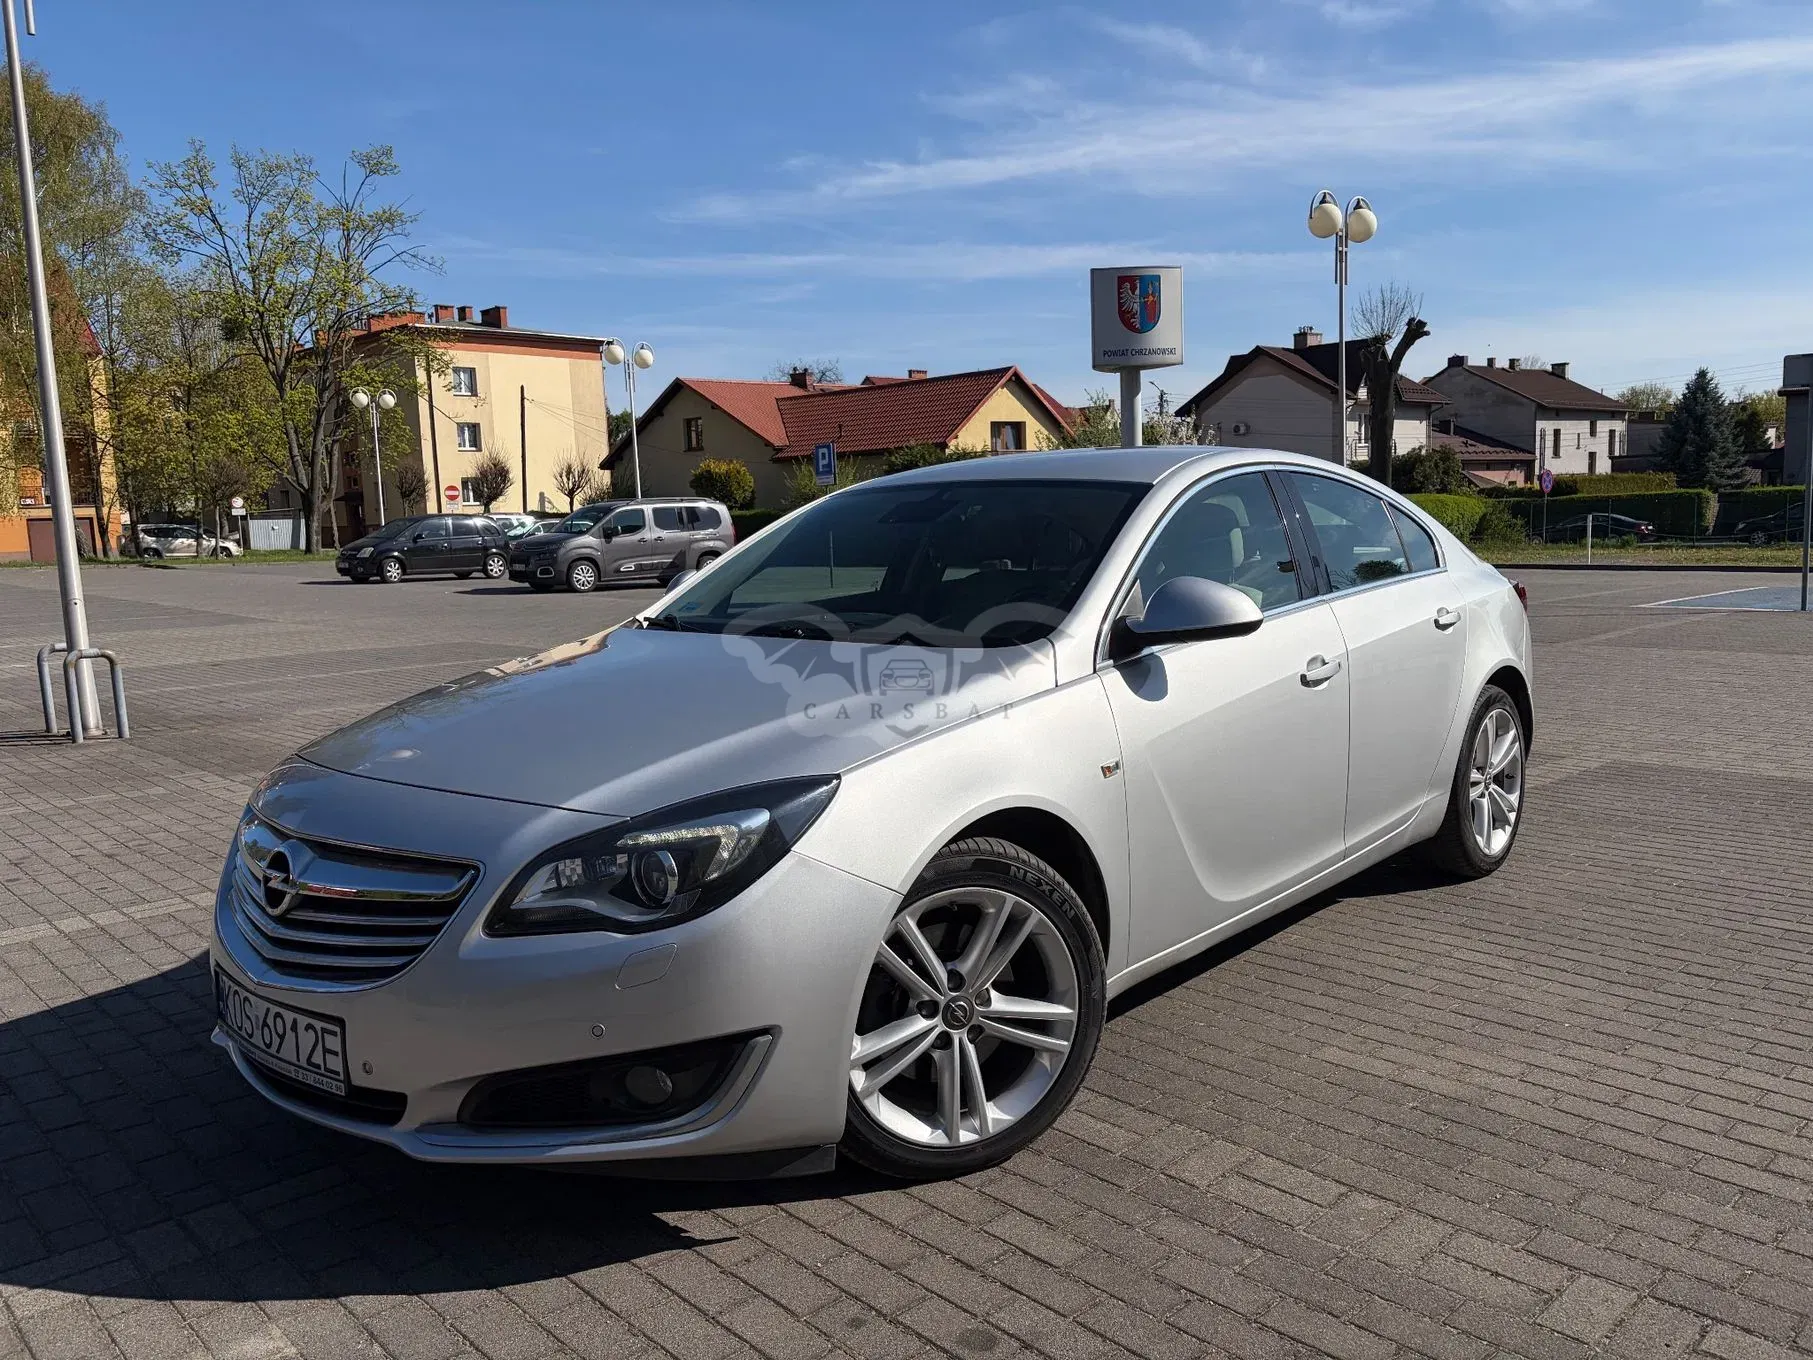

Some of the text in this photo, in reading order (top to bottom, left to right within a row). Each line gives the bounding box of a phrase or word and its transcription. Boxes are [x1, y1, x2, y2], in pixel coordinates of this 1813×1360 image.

[1103, 347, 1177, 358] POWIAT CHRZANOWSKI
[818, 447, 829, 472] P
[1009, 865, 1076, 919] NEXEN
[223, 980, 341, 1077] KOS 6912E
